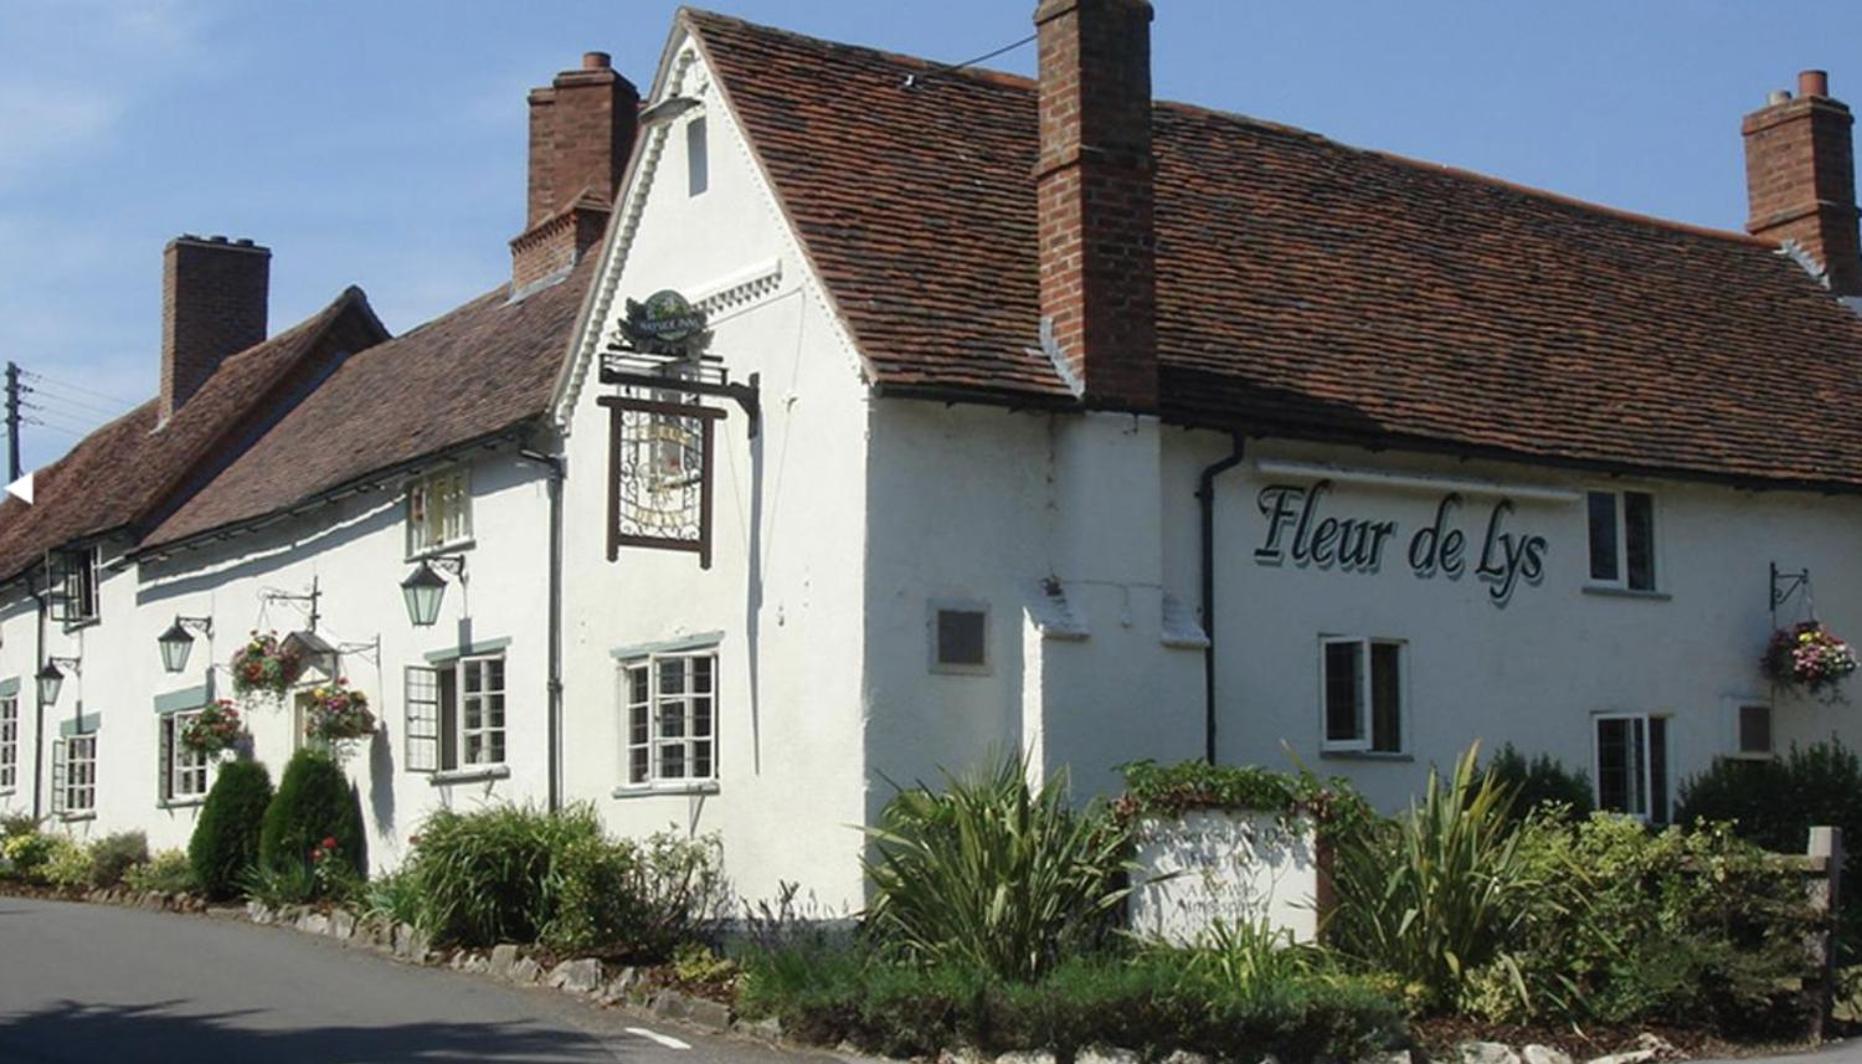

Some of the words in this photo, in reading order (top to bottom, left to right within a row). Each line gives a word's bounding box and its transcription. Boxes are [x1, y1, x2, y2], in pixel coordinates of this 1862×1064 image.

[1254, 478, 1395, 571] Fleur
[1409, 491, 1465, 577] de
[1475, 499, 1547, 606] Lys
